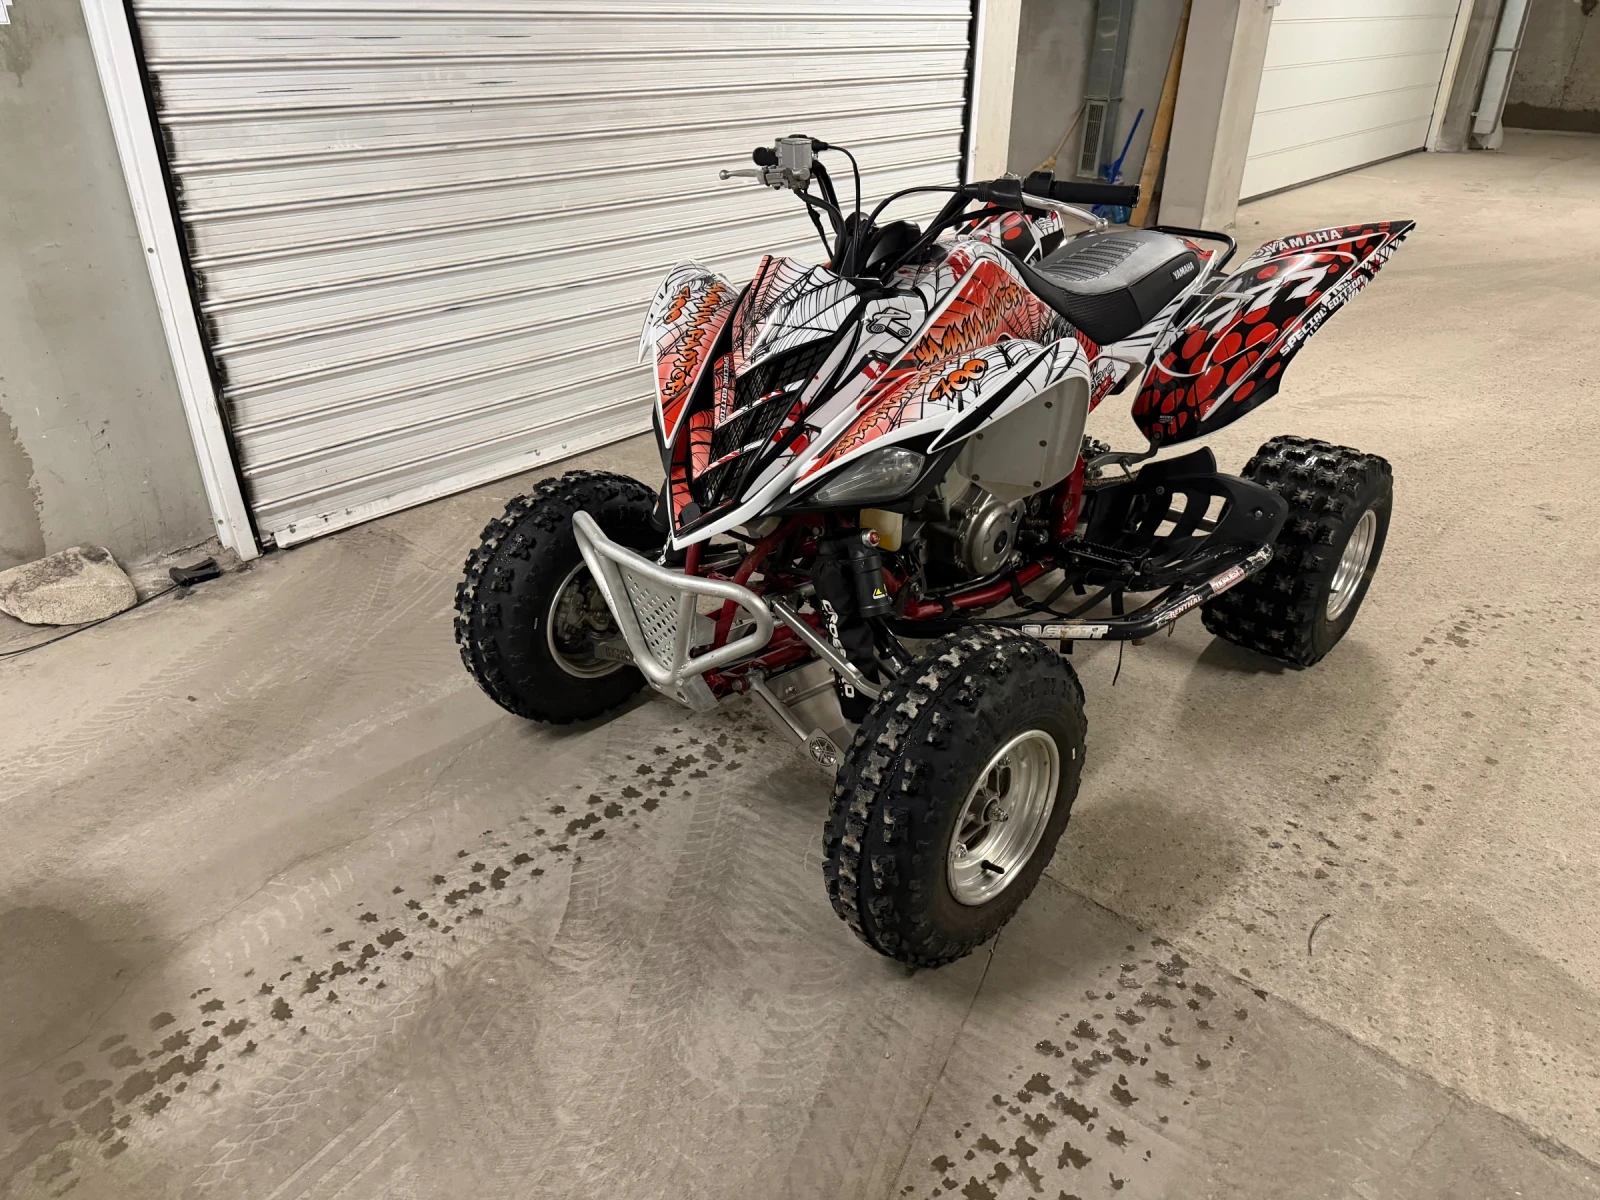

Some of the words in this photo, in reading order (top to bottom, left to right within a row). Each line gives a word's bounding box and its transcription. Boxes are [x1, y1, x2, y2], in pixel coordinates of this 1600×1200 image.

[1269, 229, 1342, 253] YAMAHA
[1173, 262, 1195, 280] YAMAHA
[686, 282, 727, 329] AMAHA
[1280, 306, 1327, 357] SPECIAL
[1327, 274, 1365, 311] EDITION
[662, 328, 707, 397] RAPTOR
[914, 312, 983, 370] YAMAHA
[927, 358, 989, 403] 700
[1168, 593, 1203, 619] RENTHAL
[822, 599, 855, 698] CROSSO
